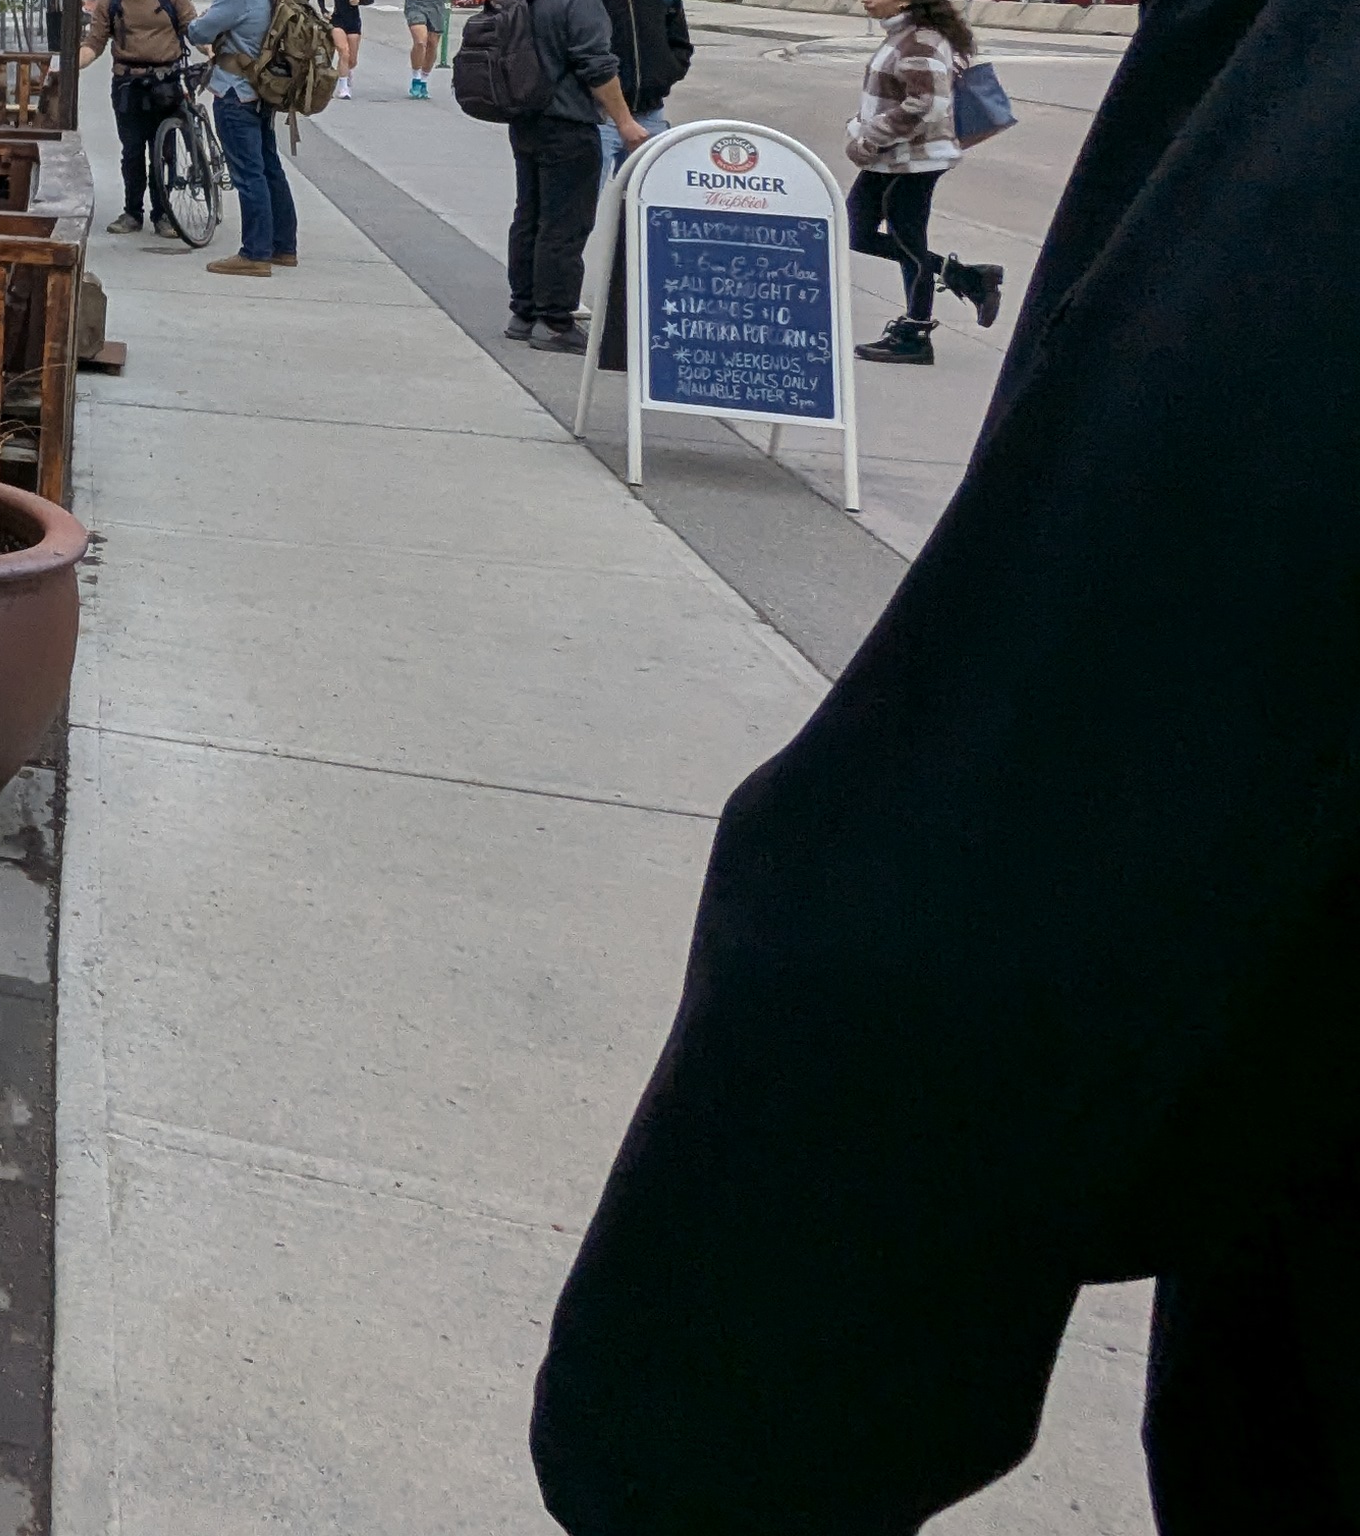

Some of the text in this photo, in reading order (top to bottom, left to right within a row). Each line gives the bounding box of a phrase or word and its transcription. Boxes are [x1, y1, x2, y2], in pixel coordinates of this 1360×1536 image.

[686, 170, 788, 195] ERDINGER
[712, 277, 796, 300] DRAUGHT
[680, 297, 754, 318] NACHOS
[681, 318, 741, 341] PAPRIKA
[693, 349, 716, 365] ON
[678, 365, 818, 392] FOOD SPECIALS ONLY
[676, 380, 741, 401] AVAILABLE
[745, 386, 785, 402] AFTER
